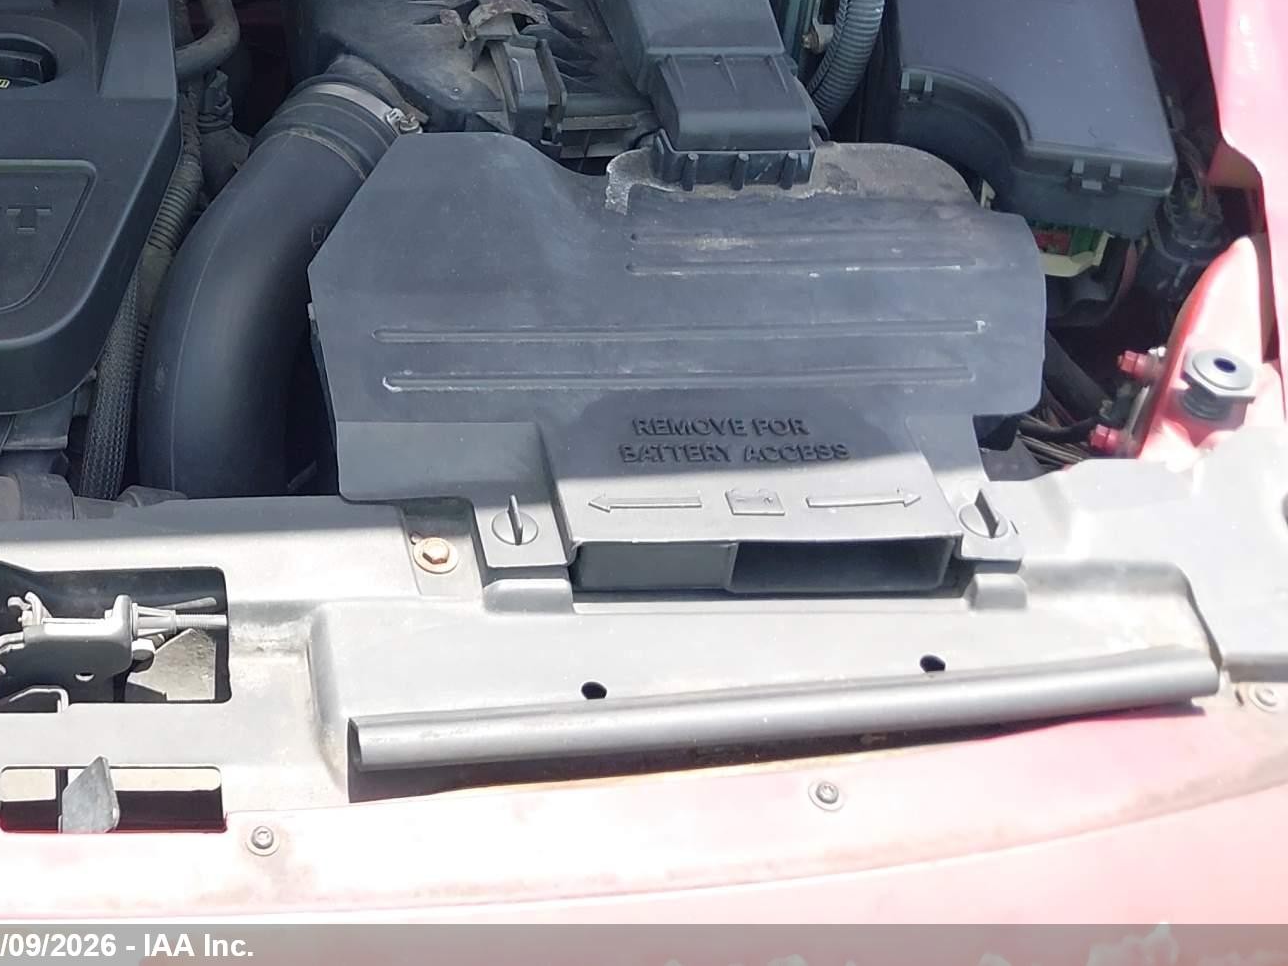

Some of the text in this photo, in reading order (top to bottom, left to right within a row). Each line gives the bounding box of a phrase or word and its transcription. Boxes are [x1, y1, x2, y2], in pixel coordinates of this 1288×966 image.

[631, 418, 810, 437] REMOVE FOR
[618, 443, 850, 463] BATTERY ACCESS
